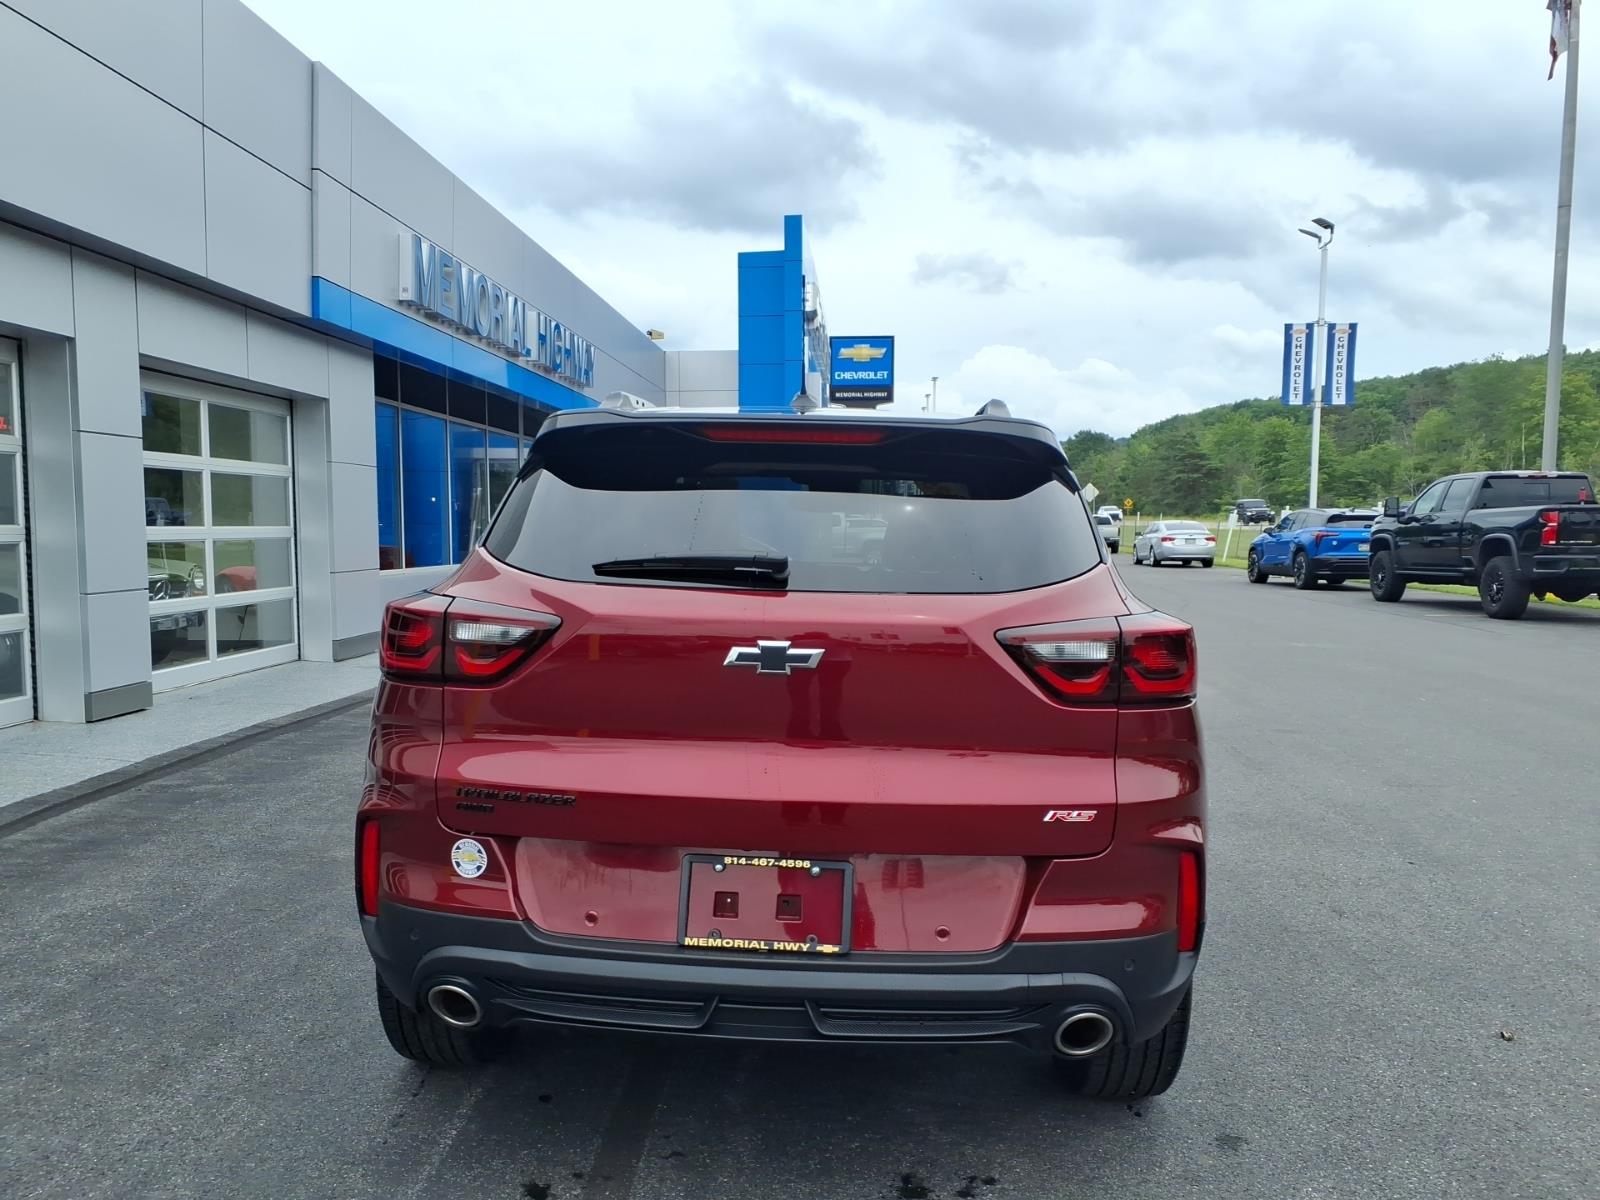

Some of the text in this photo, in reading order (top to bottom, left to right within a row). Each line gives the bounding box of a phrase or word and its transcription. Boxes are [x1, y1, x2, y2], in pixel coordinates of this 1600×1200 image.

[413, 233, 532, 358] MEMORIAL
[1293, 336, 1303, 399] CHEVROLET
[1335, 336, 1345, 399] CHEVROLET
[835, 371, 888, 379] CHEVROLET
[1043, 810, 1098, 821] RS
[724, 856, 811, 868] 814-467-4596
[684, 937, 810, 951] MEMORIAL HWY
